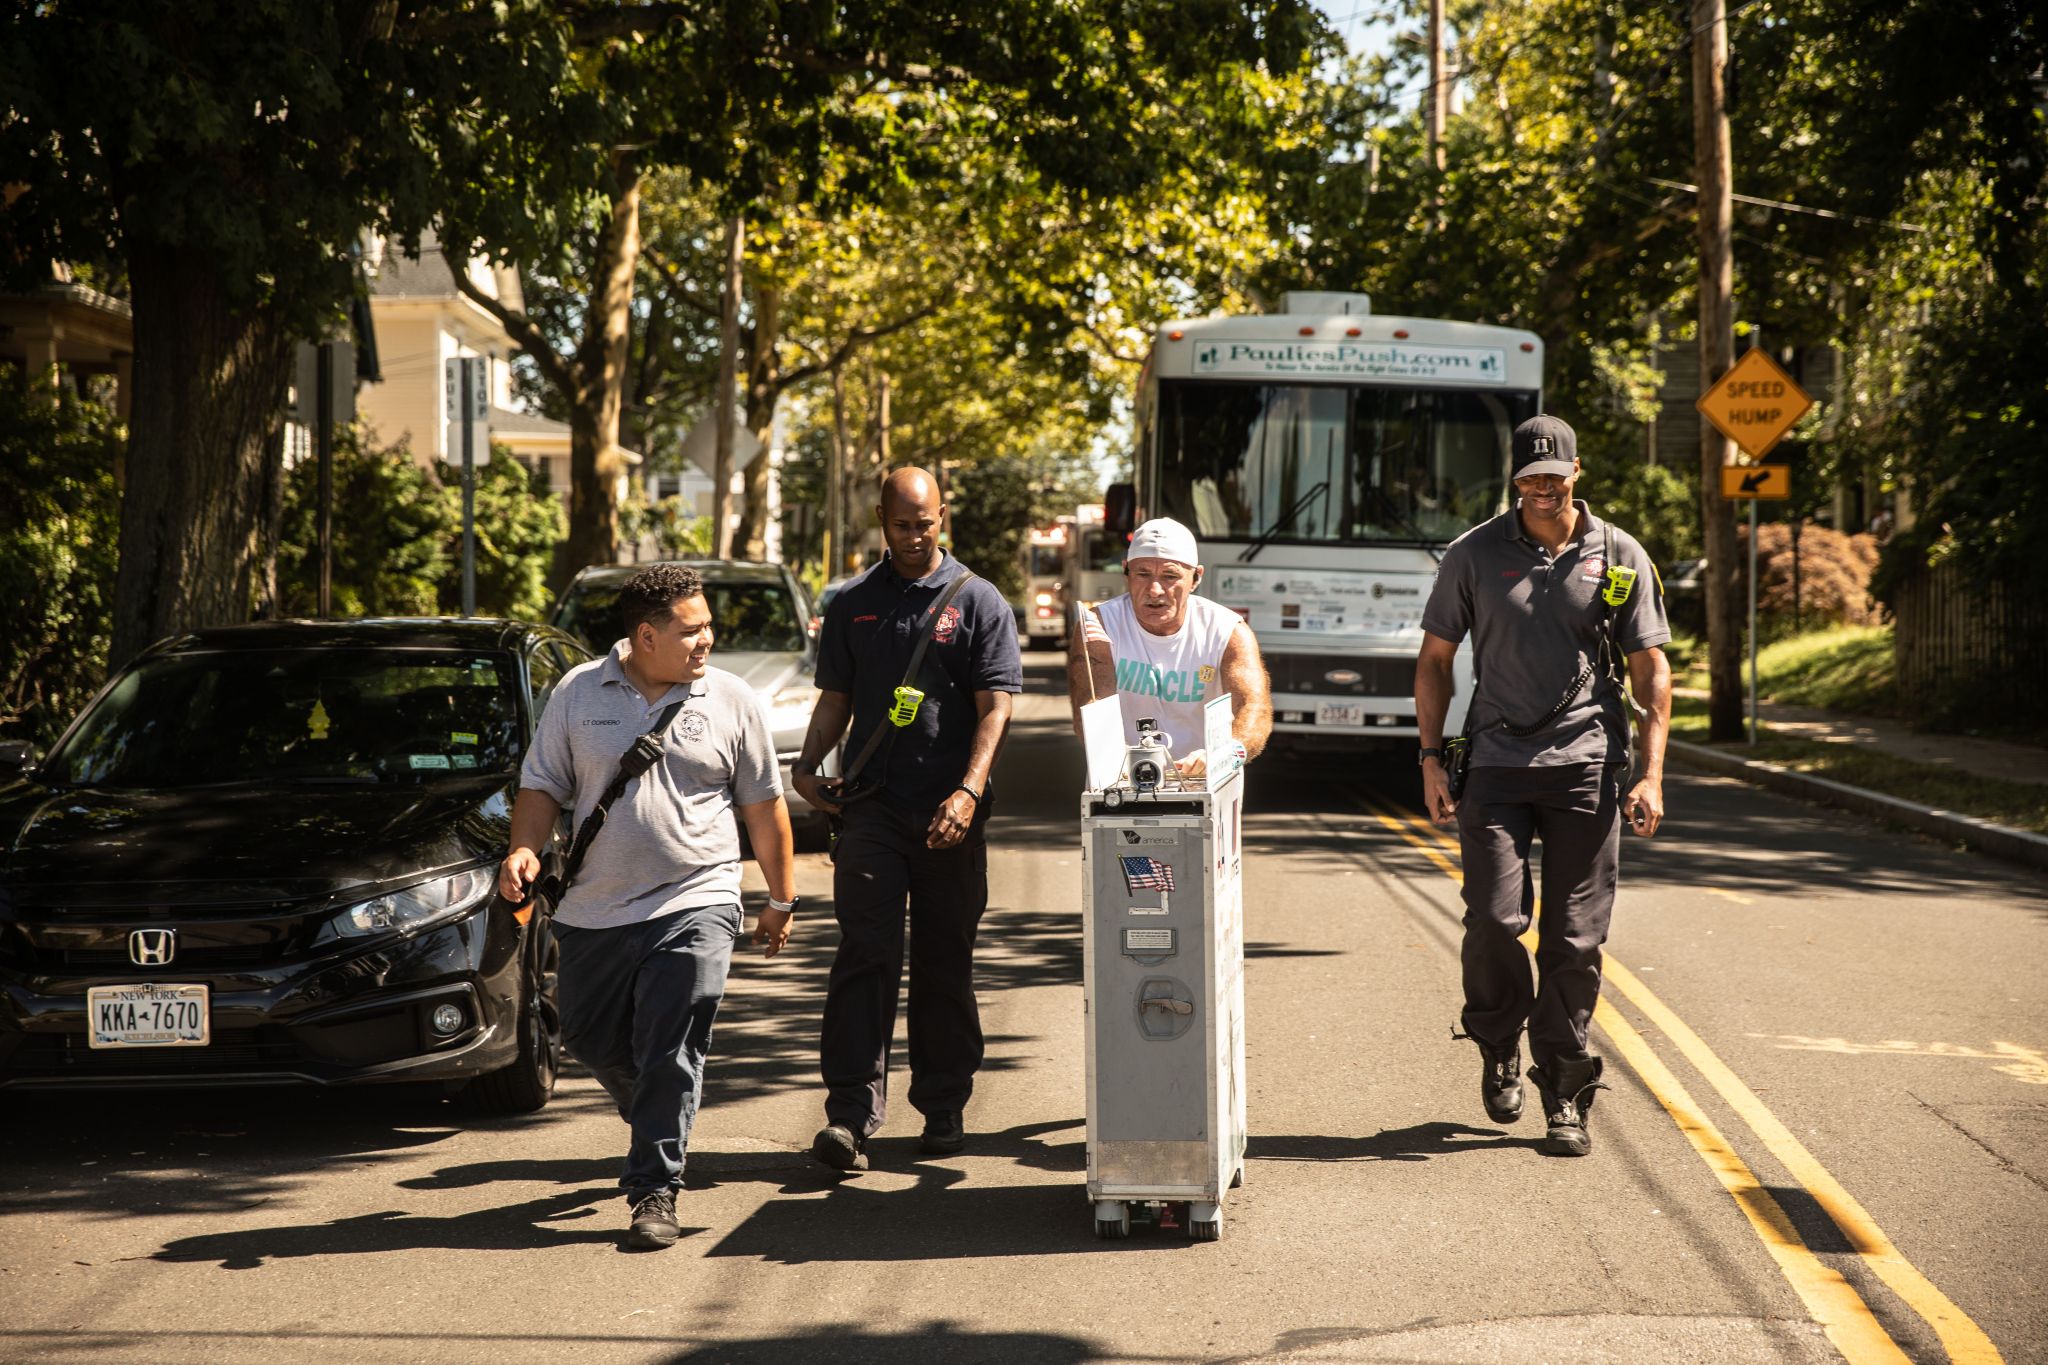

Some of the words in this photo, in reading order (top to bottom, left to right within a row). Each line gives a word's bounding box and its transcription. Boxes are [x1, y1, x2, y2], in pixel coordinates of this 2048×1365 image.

[1727, 381, 1785, 398] SPEED
[1729, 408, 1782, 425] HUMP
[120, 991, 146, 1001] NEW
[150, 990, 178, 1001] YORK
